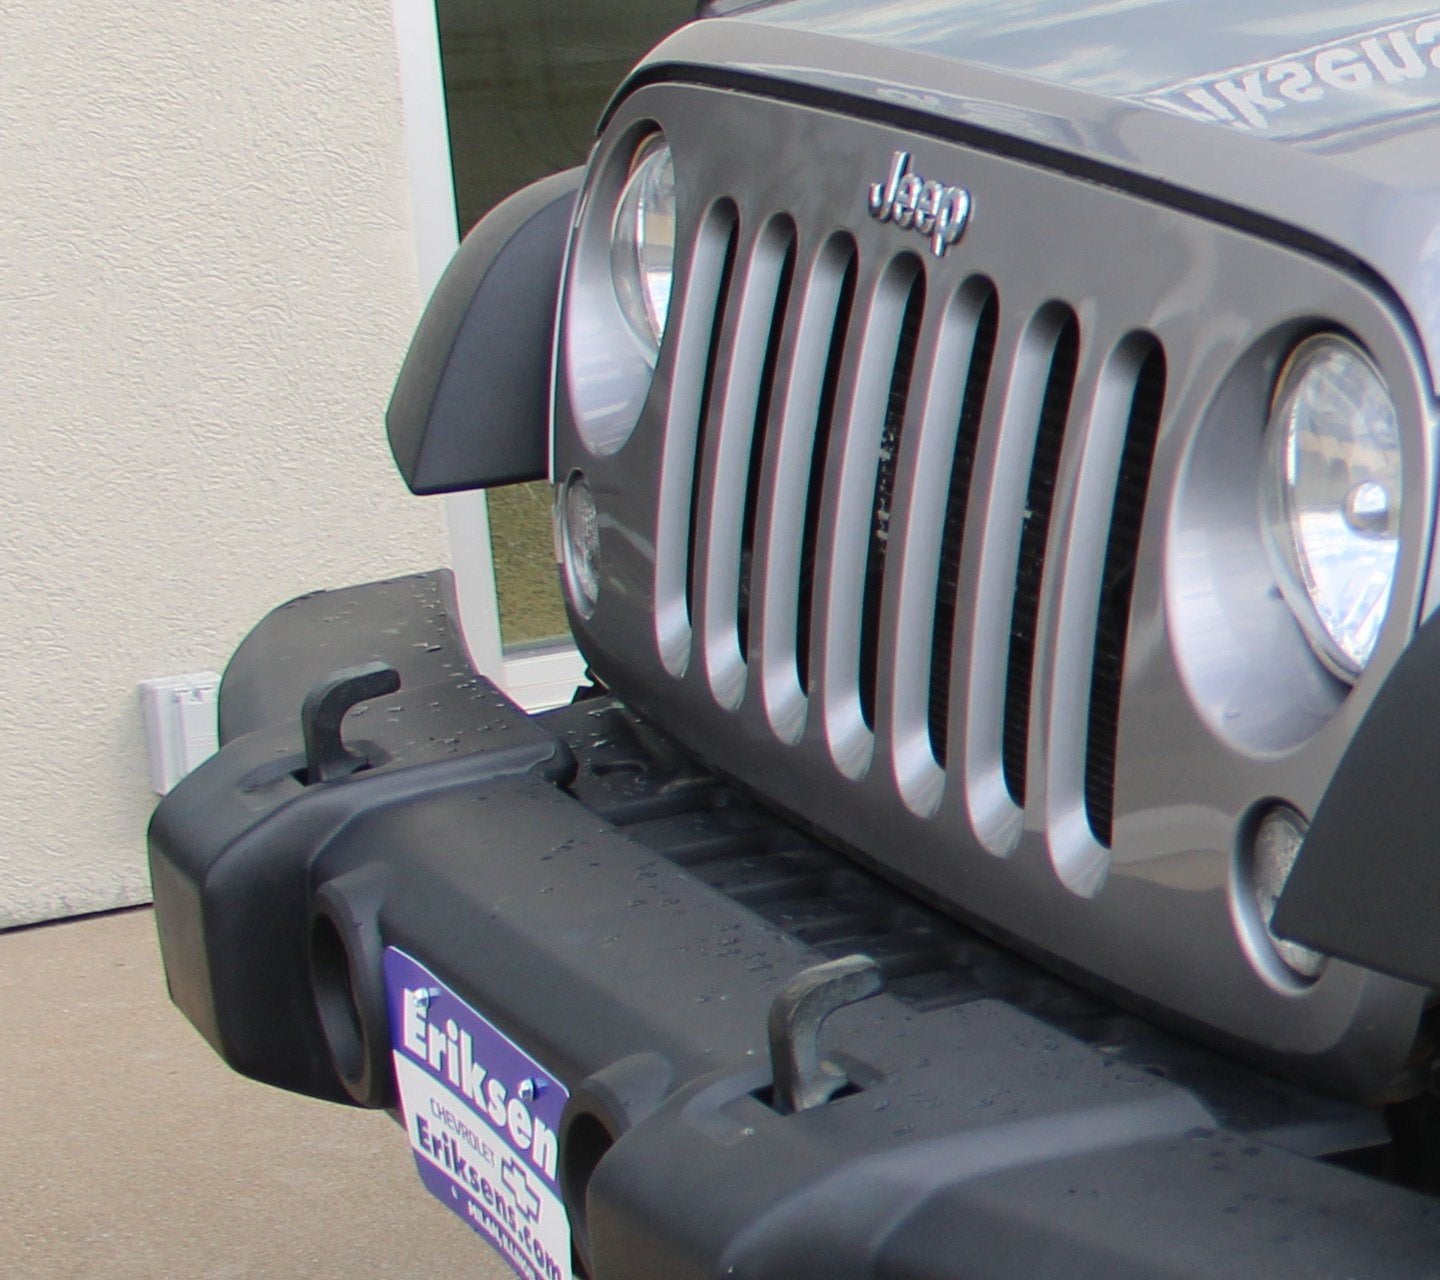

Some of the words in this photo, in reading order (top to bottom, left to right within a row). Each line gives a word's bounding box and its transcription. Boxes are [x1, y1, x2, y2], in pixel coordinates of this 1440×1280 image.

[868, 151, 973, 257] Jeep
[404, 987, 558, 1181] Eriksen
[430, 1098, 496, 1168] CHEVROLET
